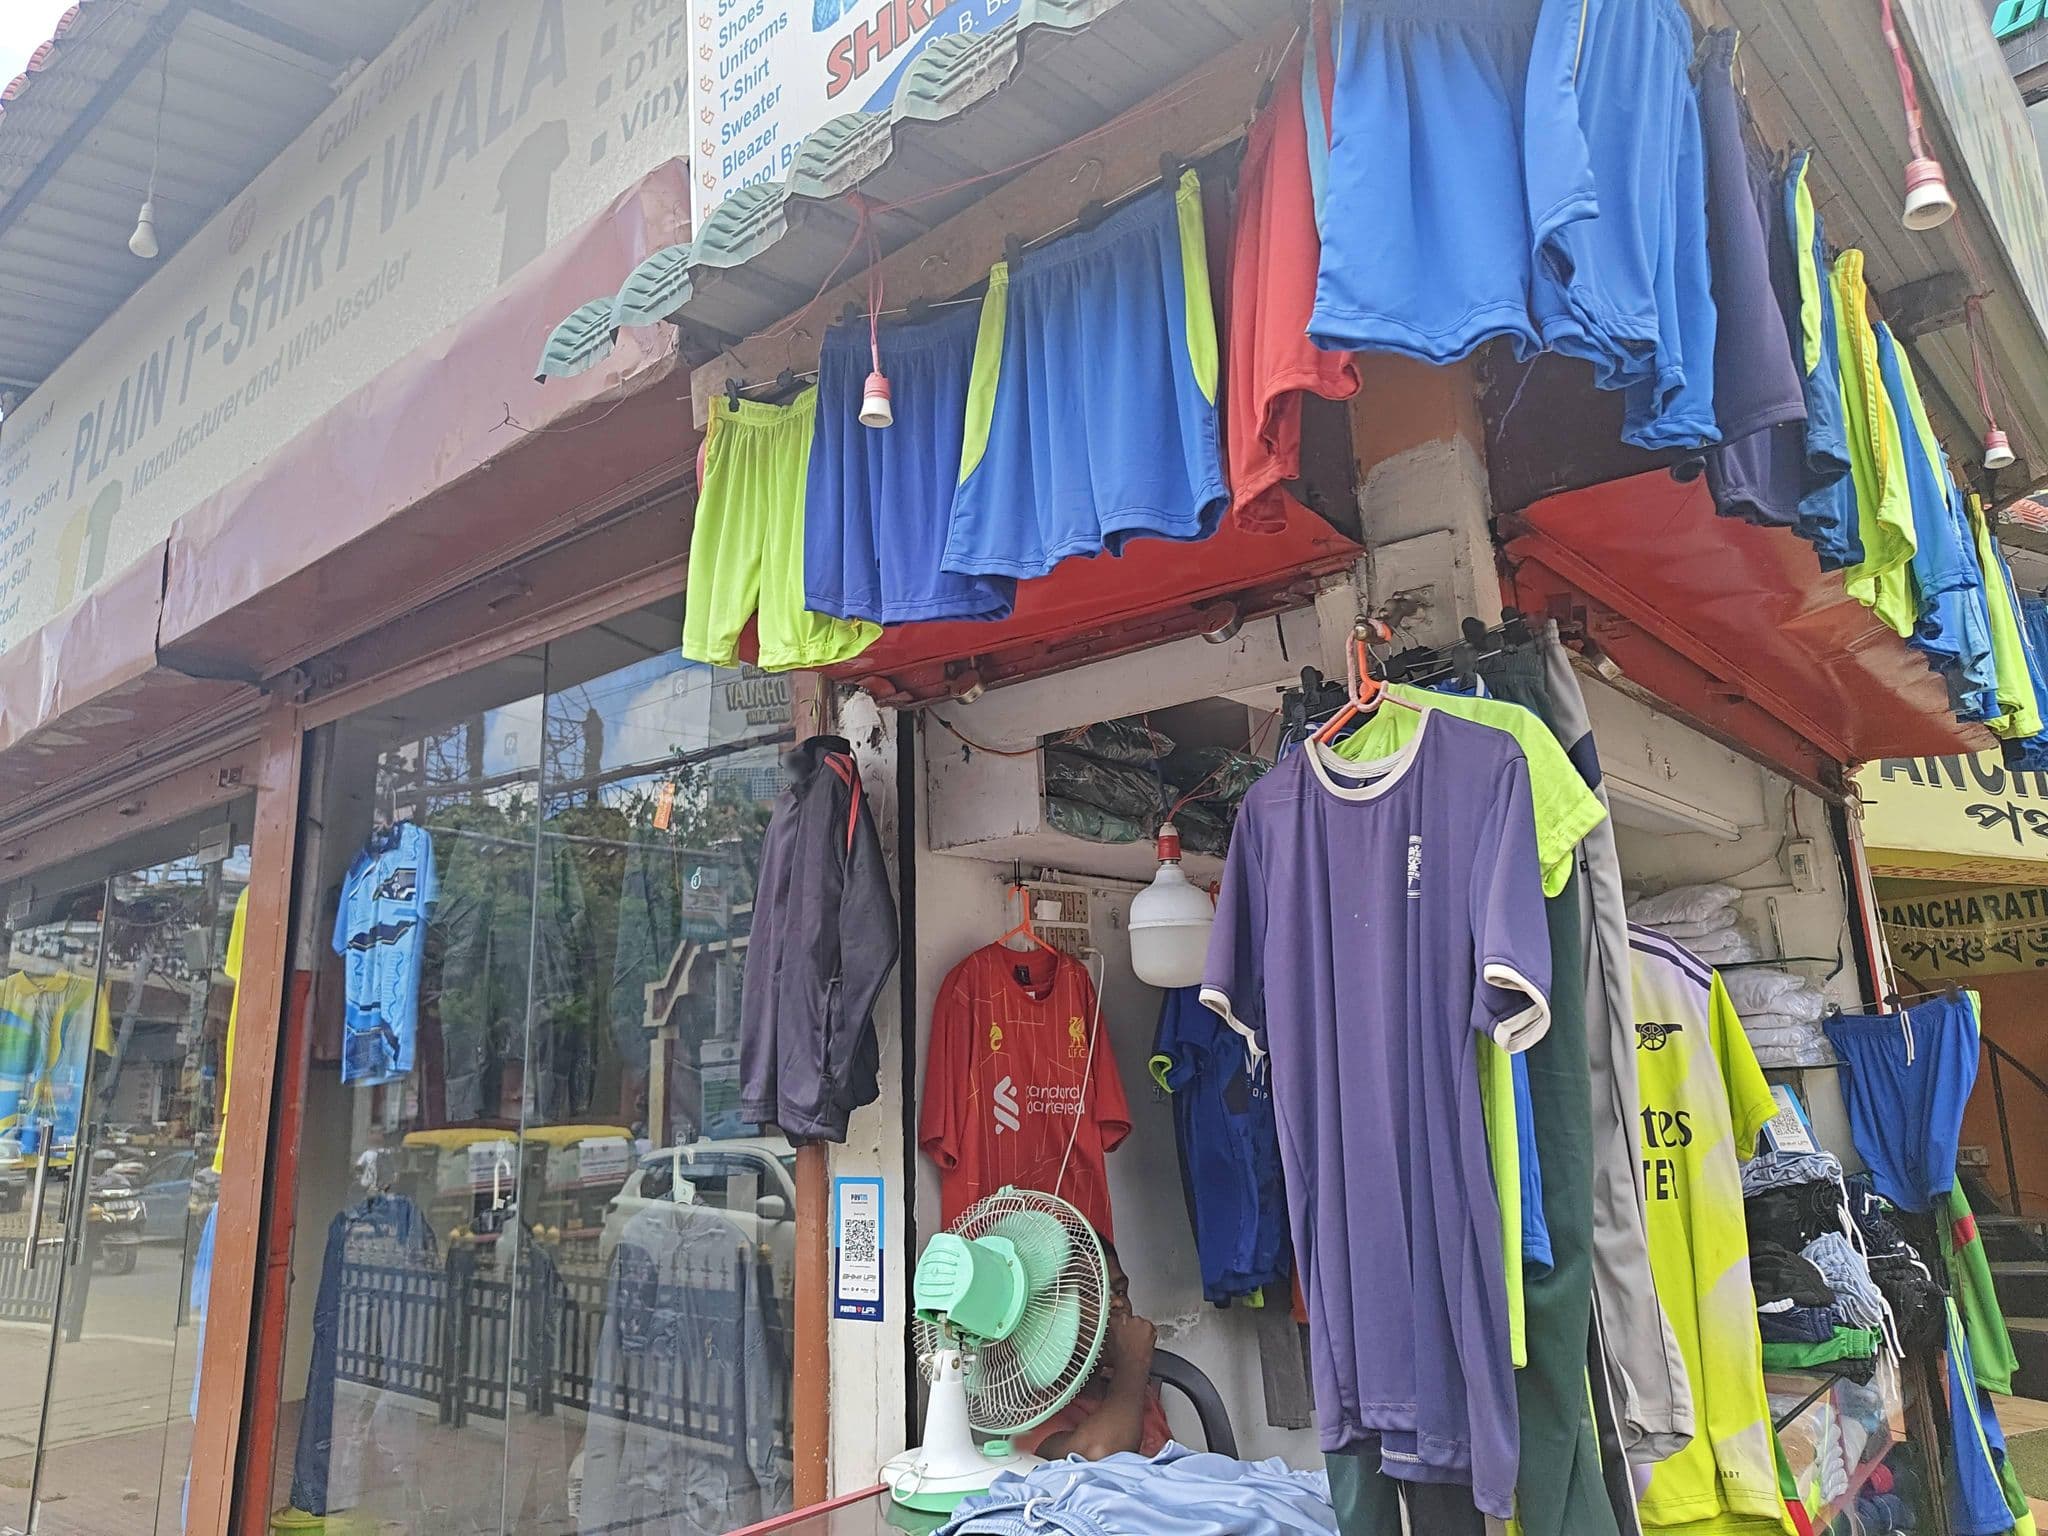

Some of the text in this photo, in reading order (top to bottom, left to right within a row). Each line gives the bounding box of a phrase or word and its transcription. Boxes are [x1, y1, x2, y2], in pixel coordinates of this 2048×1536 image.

[624, 14, 684, 91] DTF
[719, 0, 764, 49] Shoes
[719, 12, 788, 82] Uniforms
[826, 0, 948, 100] SHR
[720, 57, 770, 113] T-Shirt
[721, 81, 783, 146] Sweater
[722, 121, 779, 180] Bleazer
[66, 0, 568, 502] PLAIN T-SHIRT WALA
[131, 384, 244, 499] Manufacturer
[244, 344, 285, 408] and
[284, 247, 412, 372] Wholesaler
[22, 477, 60, 528] T-Shirt
[1068, 1048, 1088, 1059] LFC
